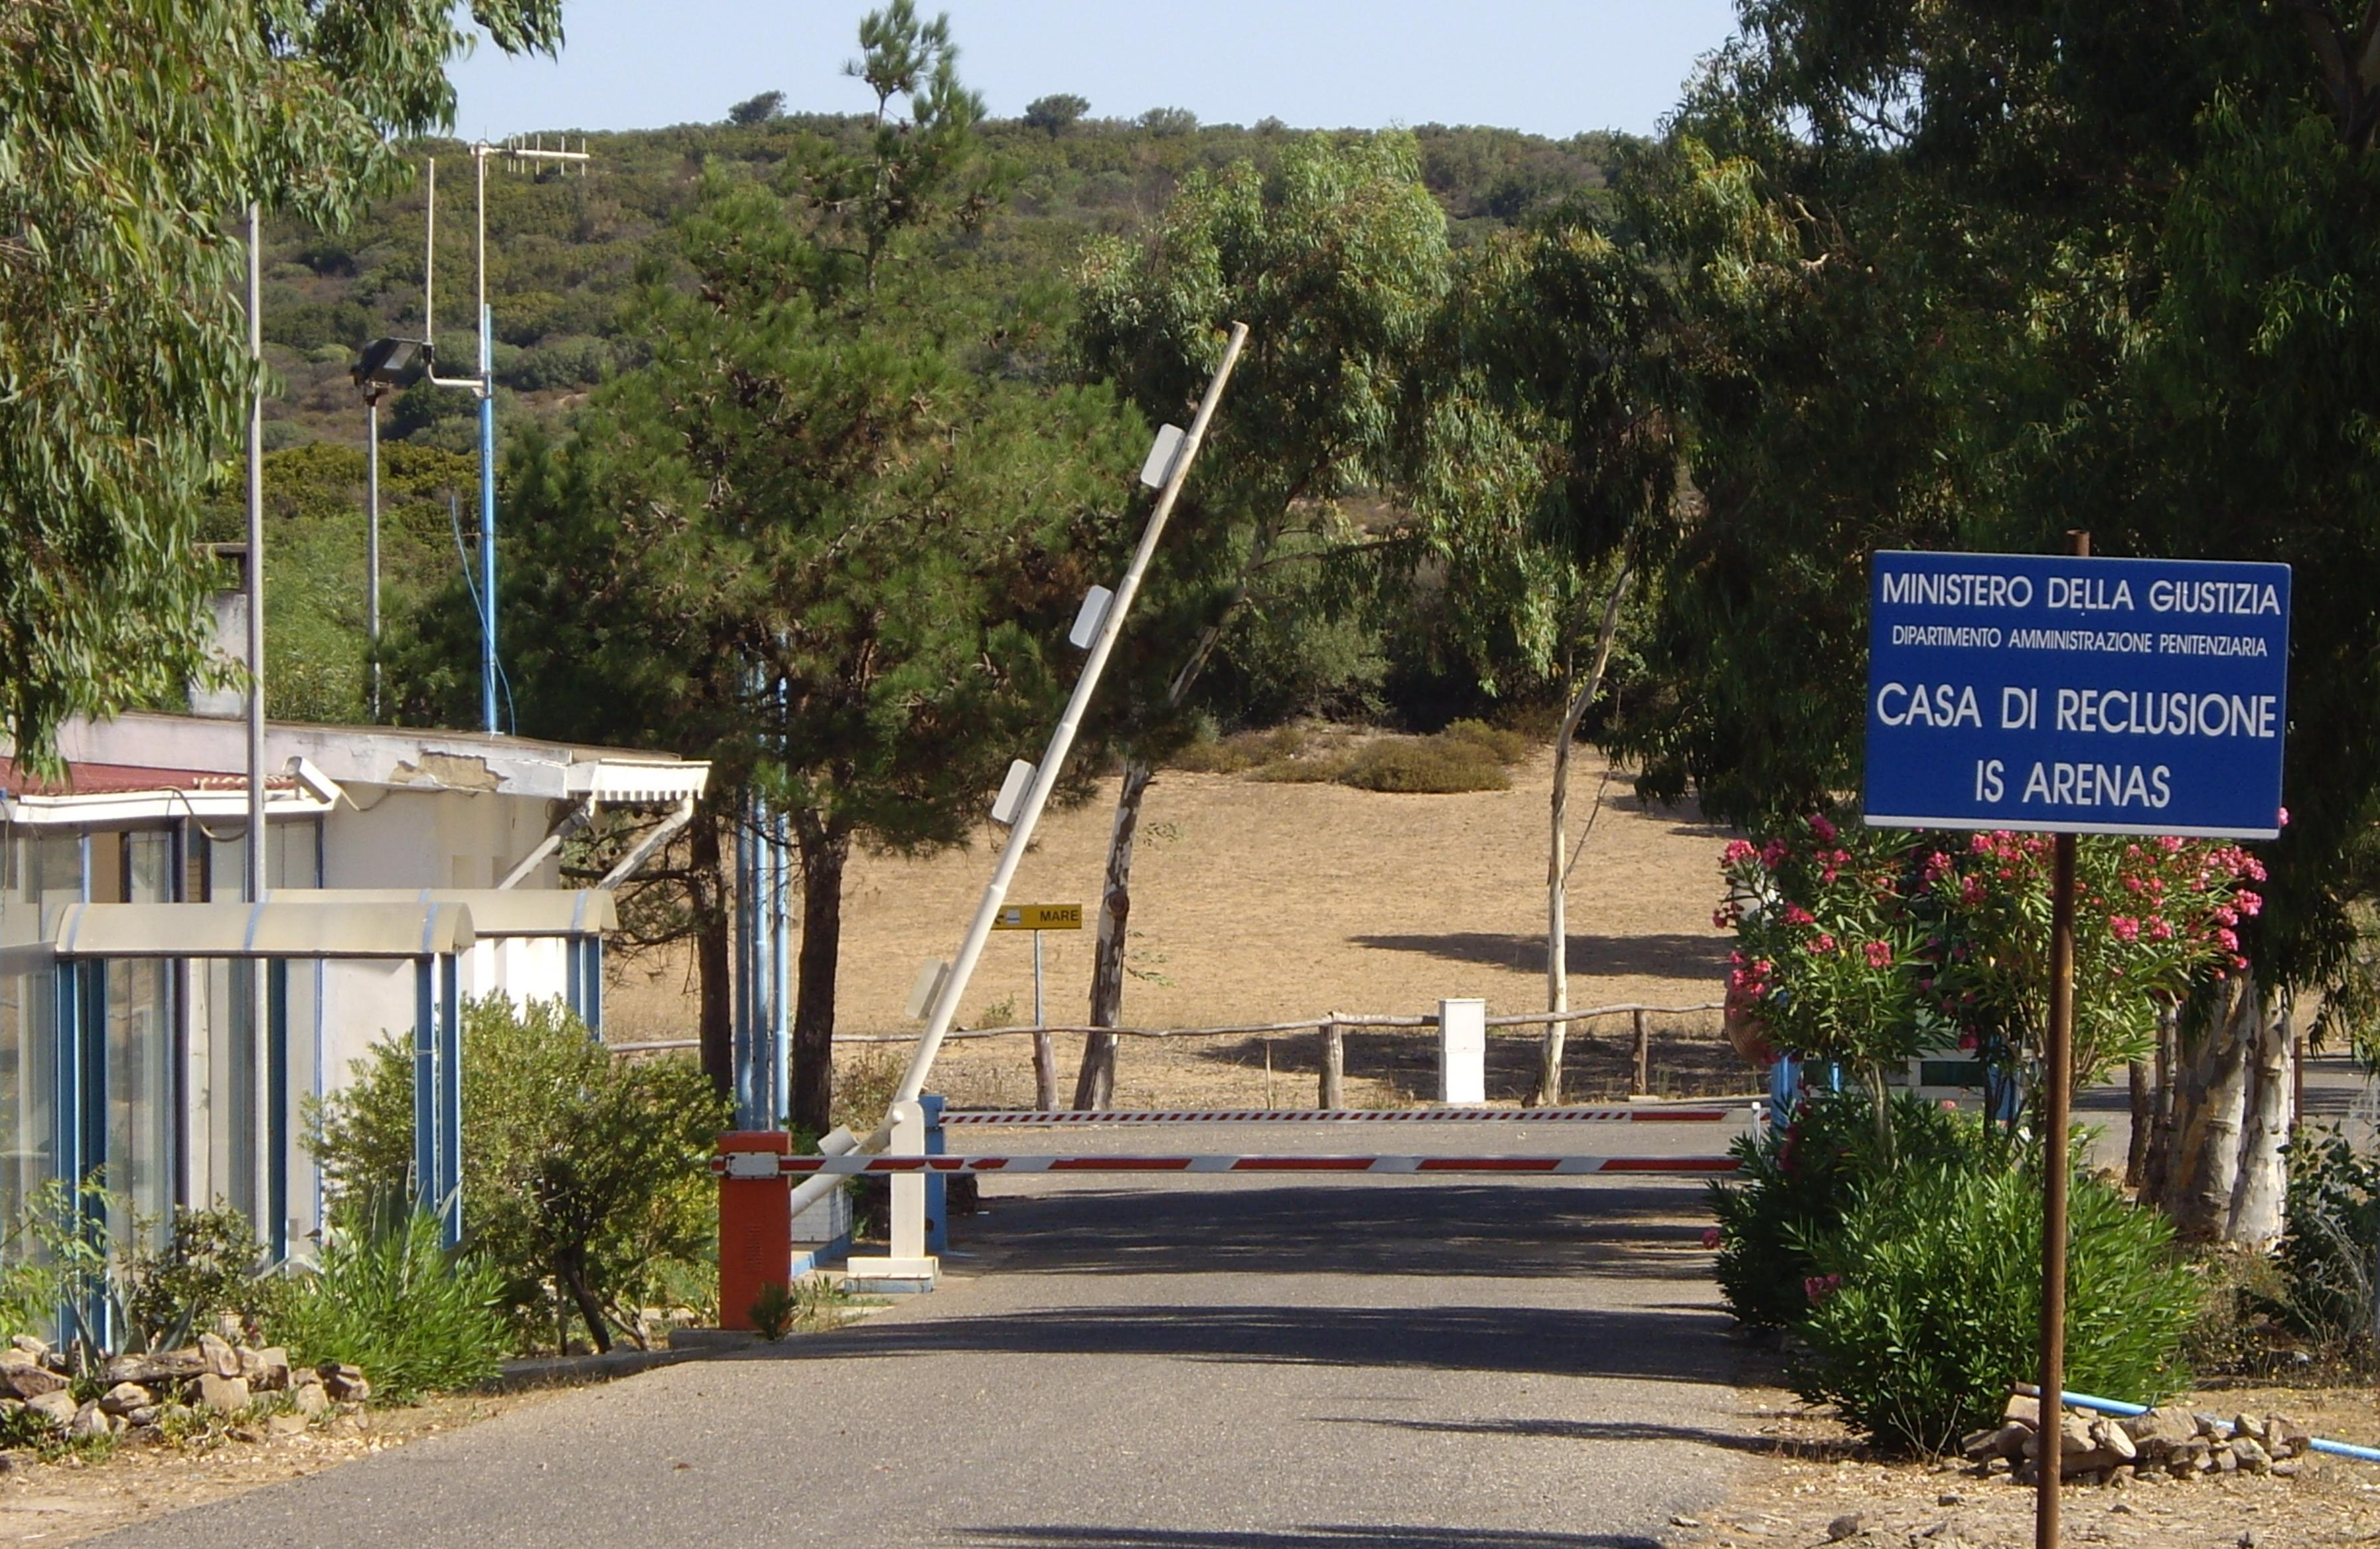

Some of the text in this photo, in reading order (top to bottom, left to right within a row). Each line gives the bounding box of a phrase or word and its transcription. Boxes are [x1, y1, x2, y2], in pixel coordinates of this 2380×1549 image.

[1883, 573, 2280, 615] MINISTERO DELLA GIUSTIZIA
[1893, 625, 2268, 656] DIPARTIMENTO AMMINISTRAZIONE PENITENZIARIA
[1876, 682, 2276, 738] CASA DI RECLUSIONE
[1976, 759, 2171, 808] IS ARENAS
[1040, 910, 1078, 922] MARE
